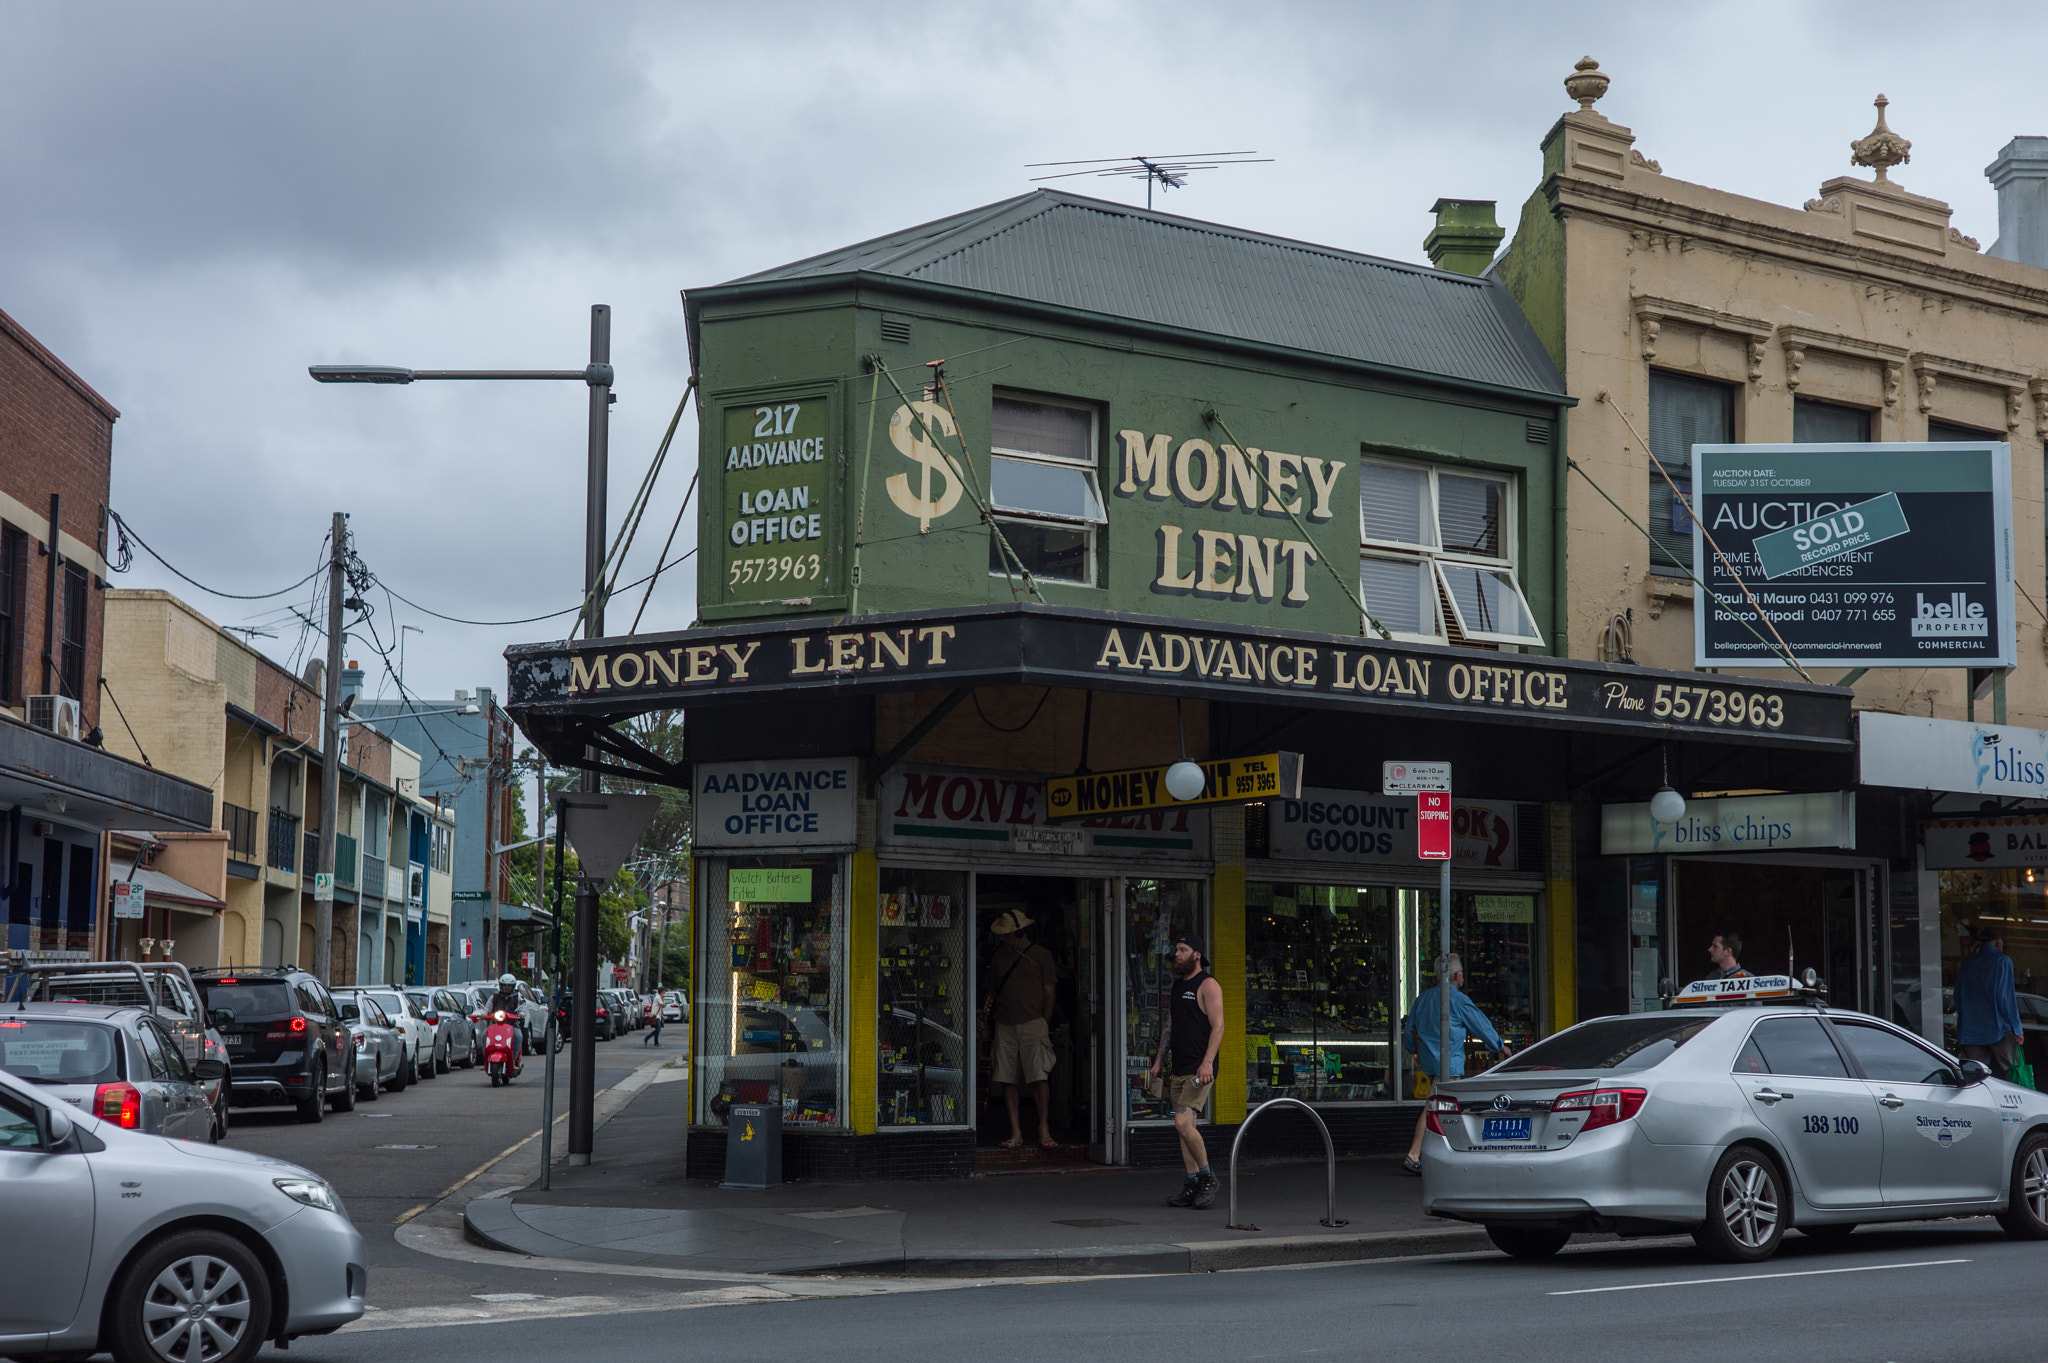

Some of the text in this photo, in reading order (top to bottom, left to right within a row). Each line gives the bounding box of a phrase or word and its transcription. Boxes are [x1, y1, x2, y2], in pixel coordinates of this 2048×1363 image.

[754, 403, 800, 438] 217
[725, 437, 824, 471] AADVANCE
[885, 386, 964, 535] $
[1119, 429, 1347, 522] MONEY
[1712, 478, 1811, 487] TUESDAY 31ST OCTOBER
[1713, 469, 1751, 477] AUCTION
[739, 486, 811, 515] LOAN
[1713, 501, 1855, 530] AUCTIO
[729, 513, 822, 546] OFFICE
[1793, 511, 1865, 552] SOLD
[1713, 552, 1750, 564] PRIME
[1801, 532, 1871, 563] RECORD PRICE
[728, 553, 821, 586] 5573963
[1156, 525, 1317, 605] LENT
[1713, 565, 1742, 577] PLUS
[1714, 592, 1894, 605] Paul Di Mauro 0431 099 976
[1916, 592, 1984, 619] belle
[1714, 609, 1896, 624] Rocco Tripodi 0407 771 655
[1917, 623, 1985, 631] PROPERTY
[1918, 641, 1985, 650] COMMERCIAL
[568, 625, 956, 693] MONEY LENT
[1096, 628, 1568, 709] AADVANCE LOAN OFFICE
[1604, 682, 1784, 729] Phone 5573963
[1243, 762, 1267, 773] TEL
[1993, 746, 2045, 785] bliss
[703, 770, 847, 794] AADVANCE
[1076, 770, 1160, 812] MONEY
[1236, 773, 1276, 794] 9557 3963
[742, 792, 810, 812] LOAN
[1428, 797, 1440, 807] NO
[724, 813, 819, 834] OFFICE
[1285, 801, 1409, 829] DISCOUNT
[1420, 811, 1449, 821] STOPPING
[1307, 828, 1392, 854] GOODS
[1676, 817, 1721, 843] bliss
[1734, 815, 1792, 847] chips
[131, 884, 143, 893] 2P
[732, 872, 802, 884] Watch Batteries
[454, 891, 482, 899] Mechanic St
[733, 887, 756, 900] Fitted
[1691, 977, 1788, 993] Silver TAXI Service
[2003, 1094, 2022, 1104] 1111
[1802, 1115, 1858, 1135] 133 100
[1916, 1115, 1973, 1129] Silver Service
